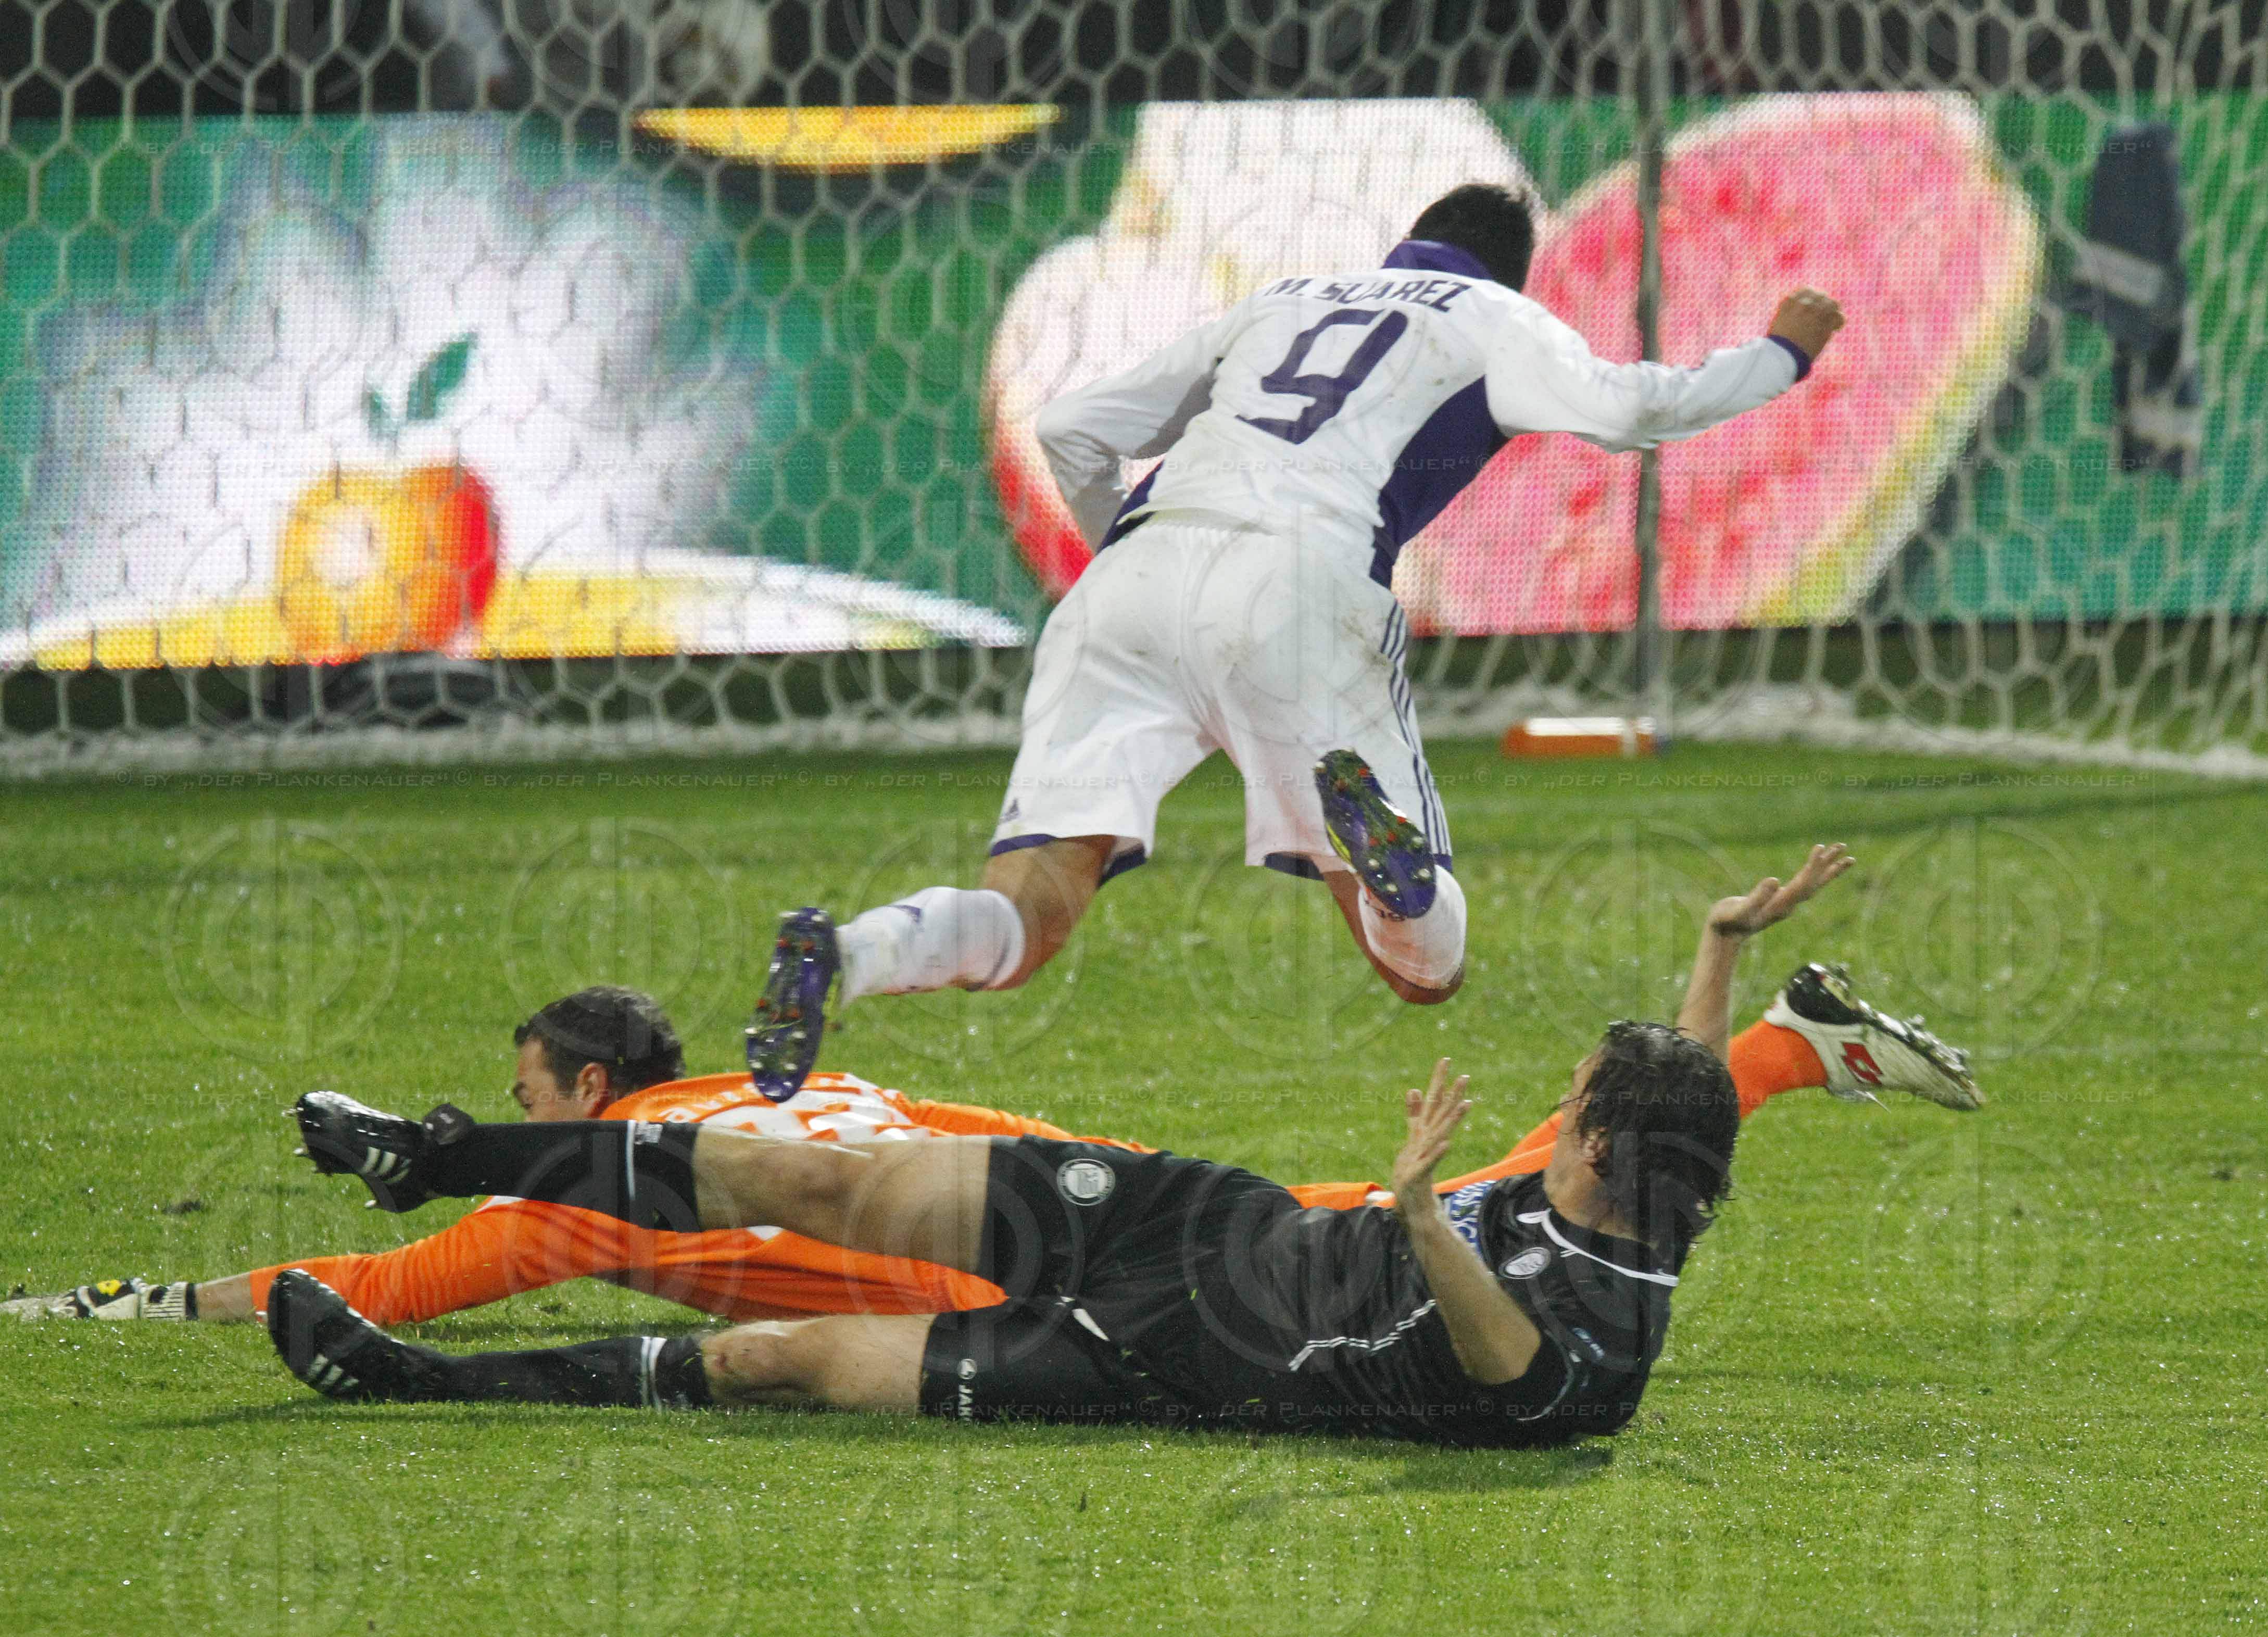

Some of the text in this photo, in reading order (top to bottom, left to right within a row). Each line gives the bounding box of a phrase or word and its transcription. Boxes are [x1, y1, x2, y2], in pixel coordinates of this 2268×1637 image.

[1264, 278, 1472, 312] M. SUAREZ
[1234, 308, 1409, 445] 9
